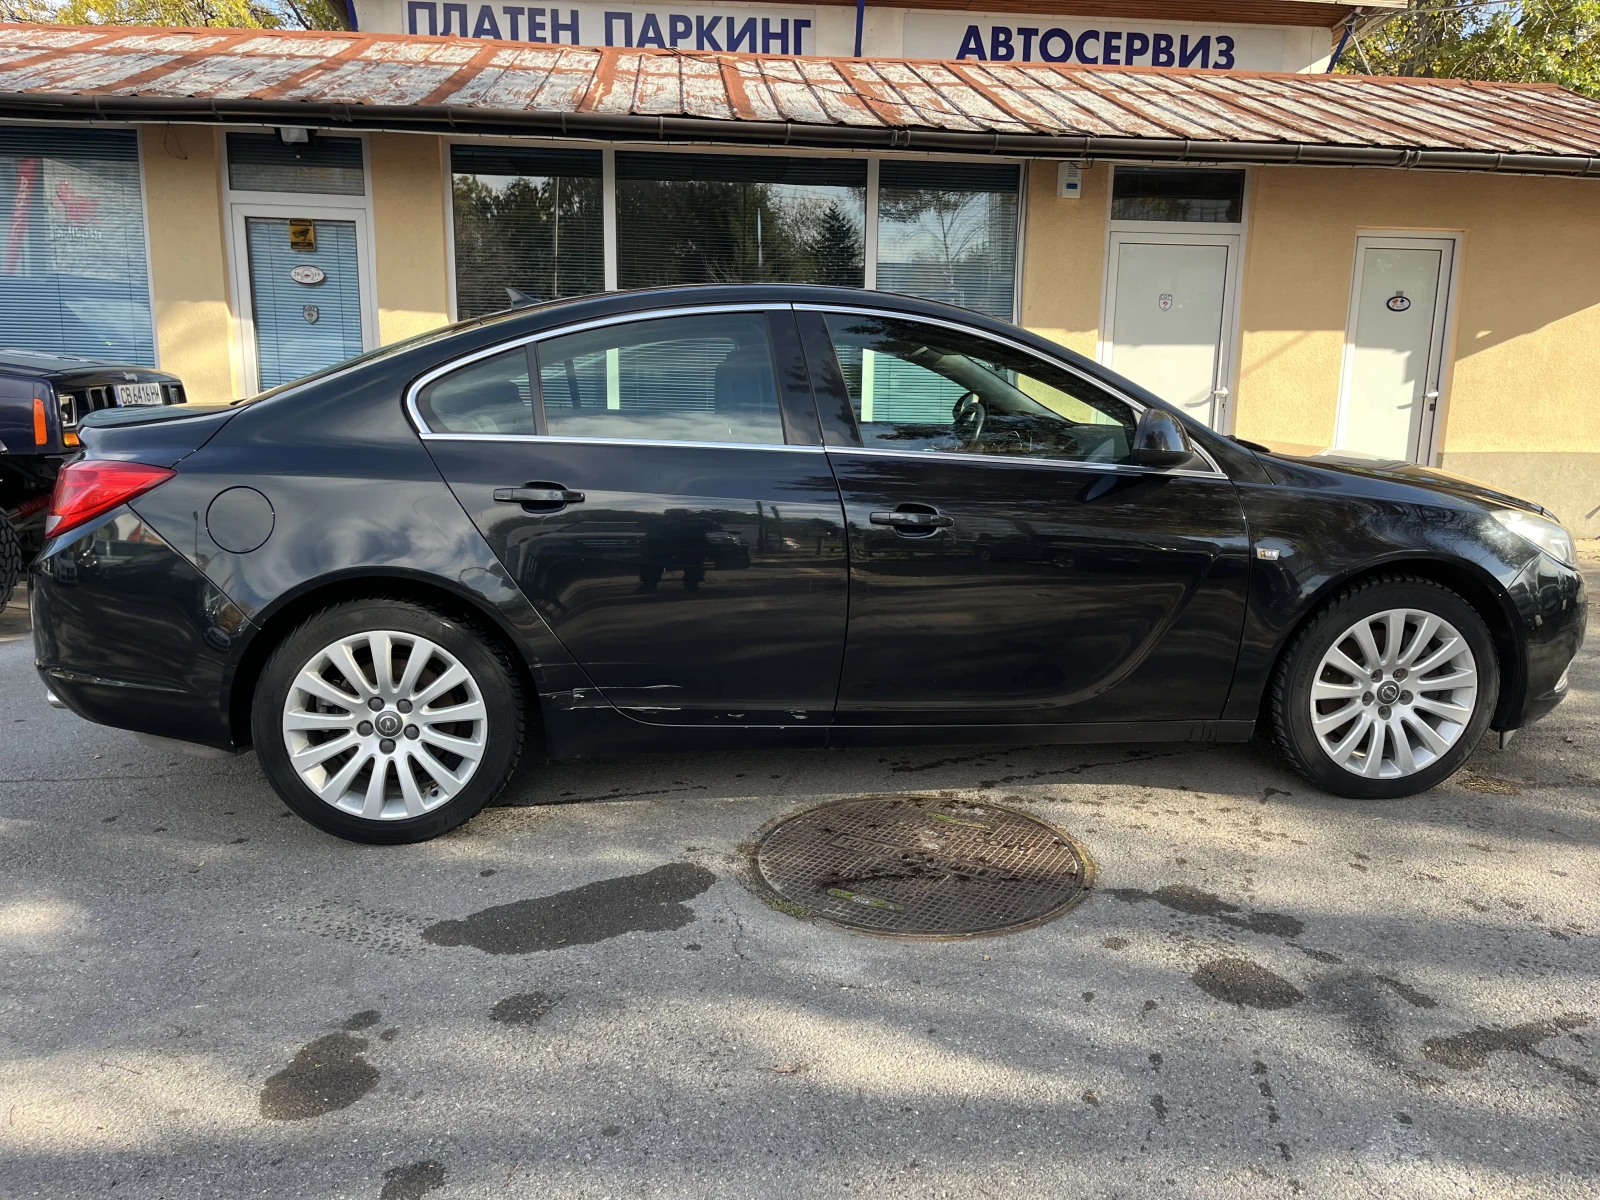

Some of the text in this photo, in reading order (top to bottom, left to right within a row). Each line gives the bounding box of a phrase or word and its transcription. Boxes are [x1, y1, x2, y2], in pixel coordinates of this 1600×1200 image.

[408, 1, 811, 55] ПЛАТЕН ПАРКИНГ
[956, 25, 1235, 69] АВТОСЕРВИЗ
